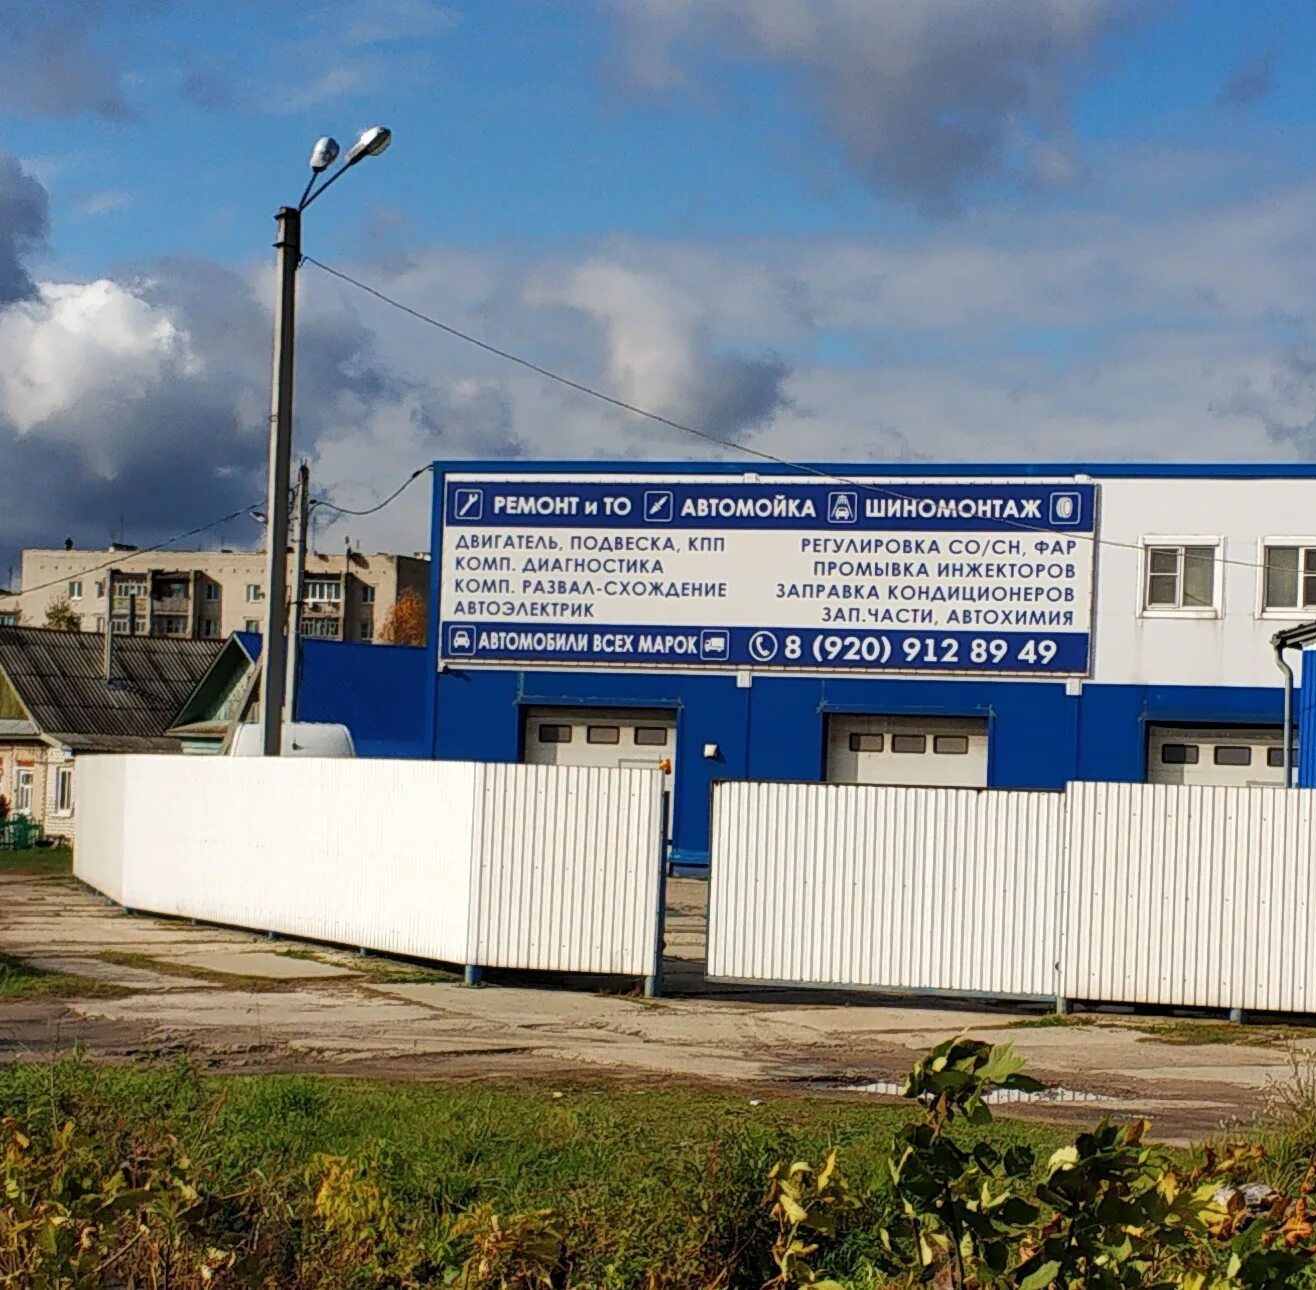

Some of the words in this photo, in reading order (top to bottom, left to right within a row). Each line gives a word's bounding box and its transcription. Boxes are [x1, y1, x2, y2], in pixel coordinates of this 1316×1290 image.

[494, 495, 580, 515] РЕМОНТ
[584, 500, 598, 515] и
[603, 496, 632, 516] ТО
[680, 494, 817, 518] АВТОМОЙКА
[865, 498, 1042, 519] ШИНОМОНТАЖ
[455, 534, 563, 552] ДВИГАТЕЛЬ,
[570, 535, 681, 553] ПОДВЕСКА,
[688, 536, 725, 552] КПП
[801, 538, 941, 555] РЕГУЛИРОВКА
[948, 539, 1026, 557] СО/СН,
[1034, 539, 1077, 555] ФАР
[455, 556, 516, 572] КОМП.
[521, 557, 664, 574] ДИАГНОСТИКА
[813, 560, 930, 578] ПРОМЫВКА
[937, 562, 1076, 579] ИНЖЕКТОРОВ
[454, 578, 515, 594] КОМП.
[522, 579, 727, 599] РАЗВАЛ-СХОЖДЕНИЕ
[775, 583, 880, 600] ЗАПРАВКА
[887, 584, 1075, 603] КОНДИЦИОНЕРОВ
[453, 600, 594, 618] АВТОЭЛЕКТРИК
[821, 606, 938, 626] ЗАП.ЧАСТИ,
[946, 609, 1074, 626] АВТОХИМИЯ
[478, 631, 589, 652] АВТОМОБИЛИ
[592, 633, 634, 653] ВСЕХ
[637, 634, 698, 654] МАРОК
[784, 635, 802, 659] 8
[812, 634, 892, 664] (920)
[902, 637, 959, 662] 912
[970, 638, 1008, 664] 89
[1017, 639, 1057, 665] 49
